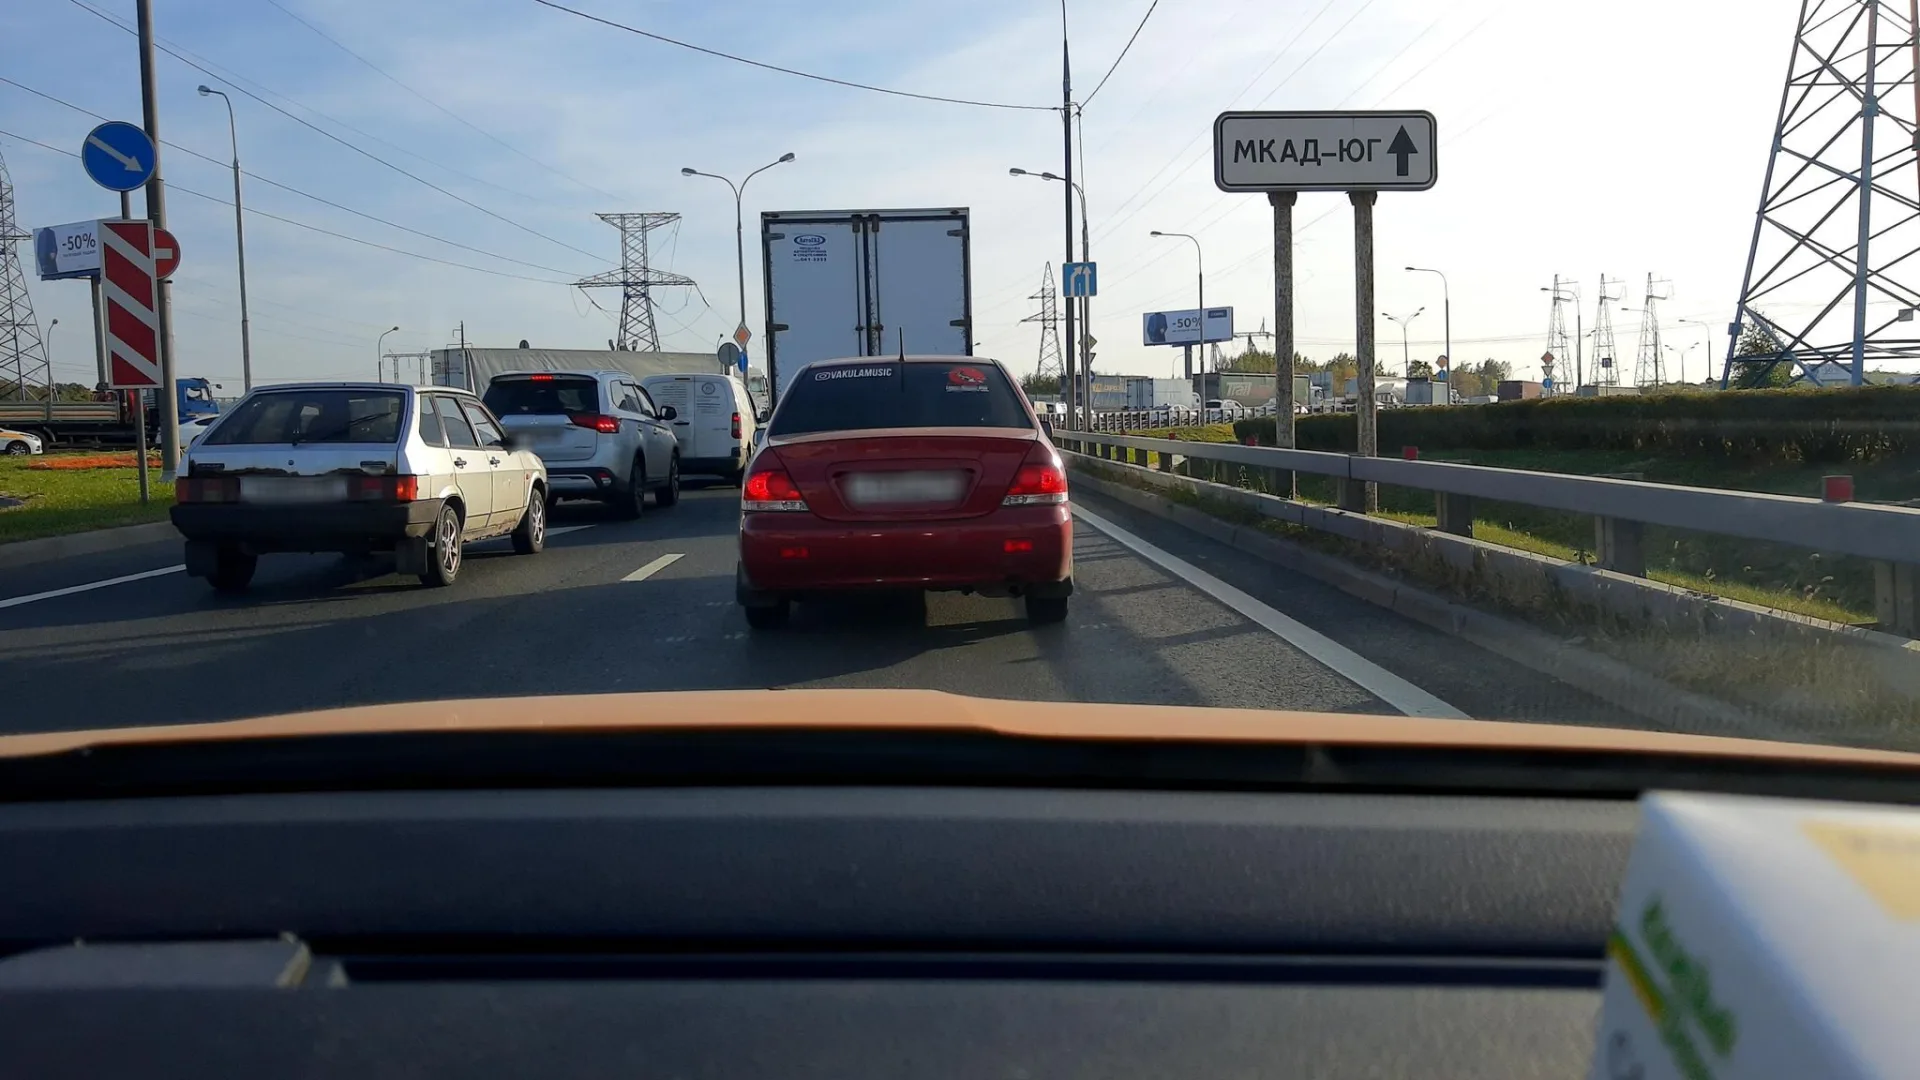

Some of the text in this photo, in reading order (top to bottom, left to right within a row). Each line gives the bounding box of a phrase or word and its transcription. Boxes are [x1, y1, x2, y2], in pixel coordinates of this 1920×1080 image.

[1233, 138, 1382, 167] МКАД-ЮГ
[62, 232, 97, 251] -50%
[831, 368, 893, 380] VAKULAMUSIC
